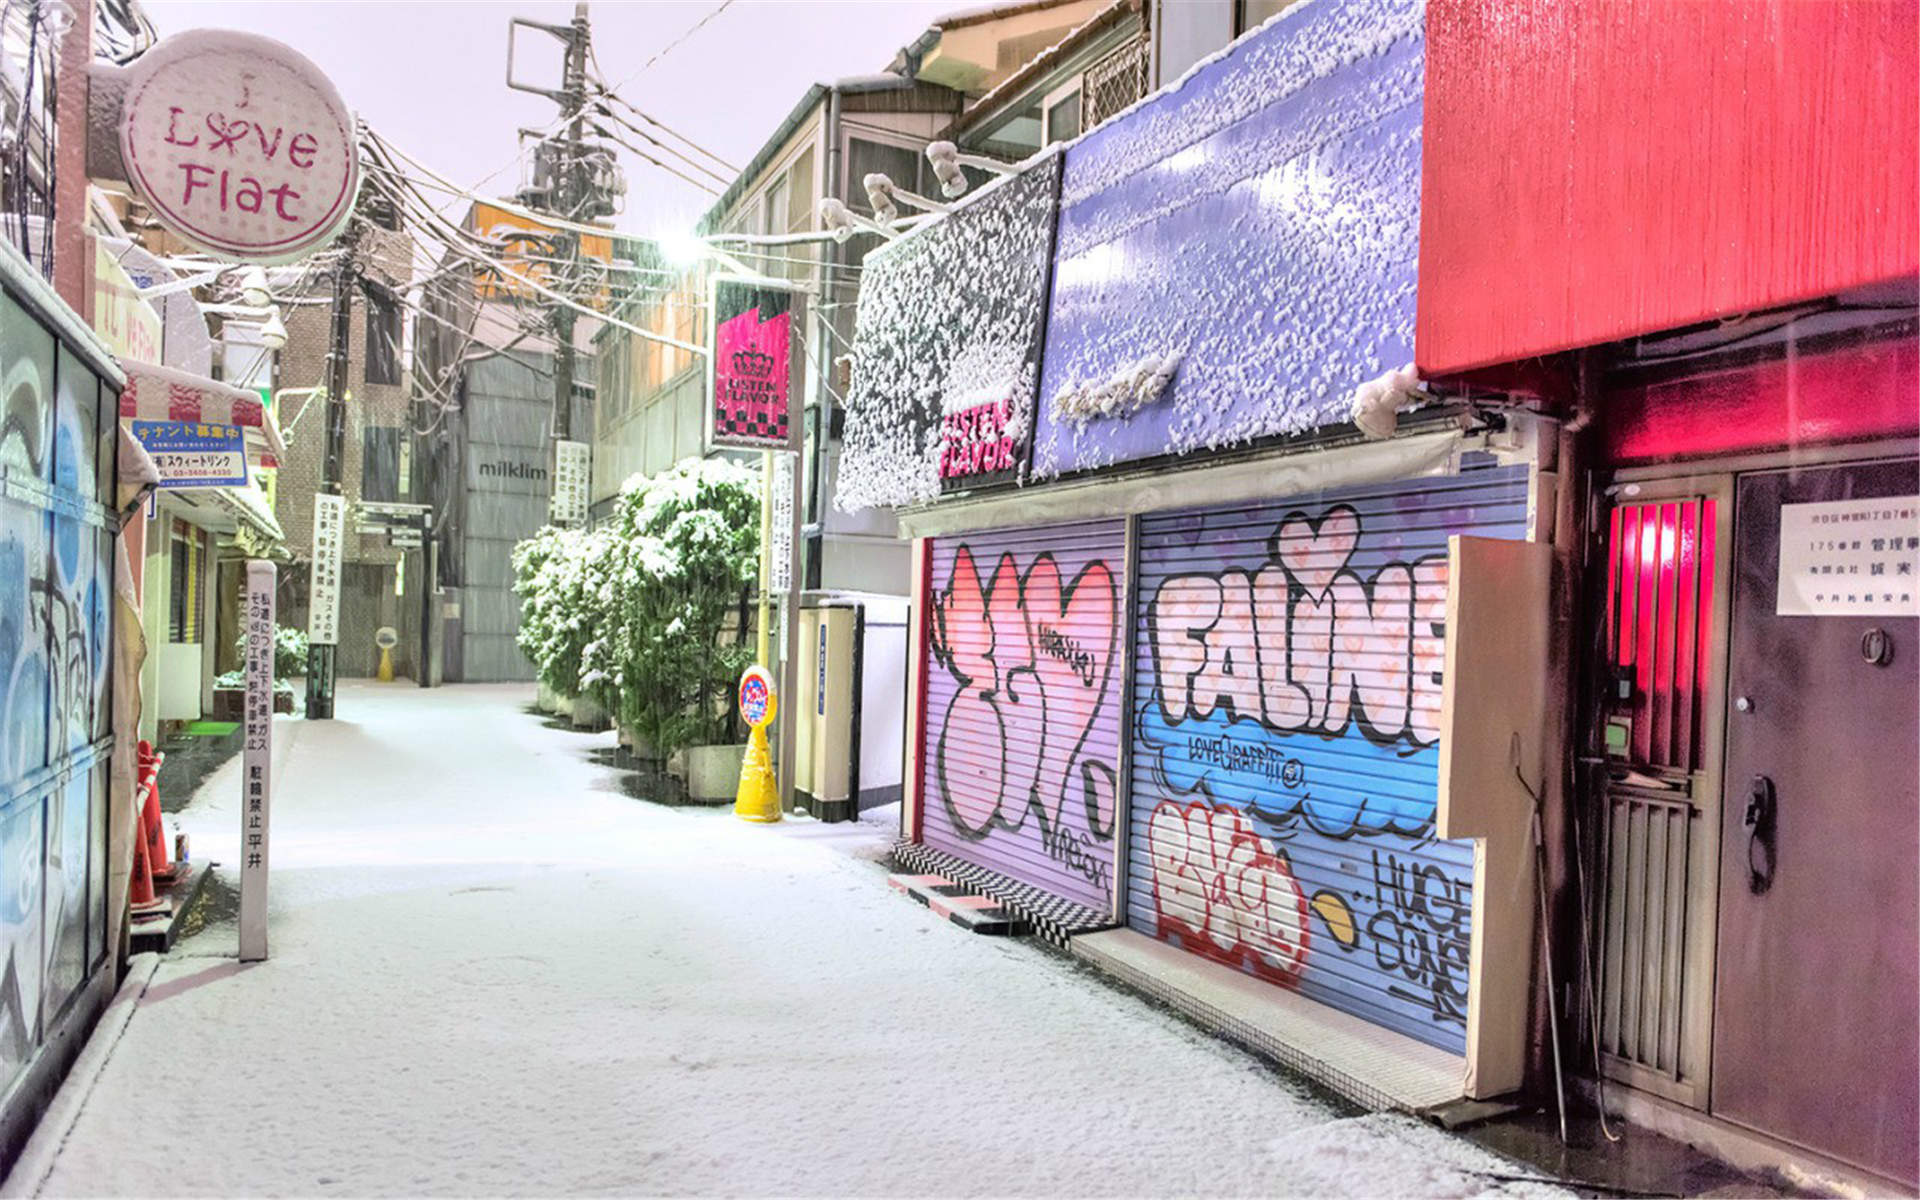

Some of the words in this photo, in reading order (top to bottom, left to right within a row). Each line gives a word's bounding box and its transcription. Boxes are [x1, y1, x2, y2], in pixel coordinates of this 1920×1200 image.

[178, 164, 301, 222] Flat
[728, 378, 777, 392] LISTEN
[726, 390, 779, 404] FLAVOR
[941, 398, 1014, 441] LISTEN
[138, 424, 240, 440] テナント募集中
[938, 436, 1016, 478] FLAVOR
[479, 461, 548, 480] milklim
